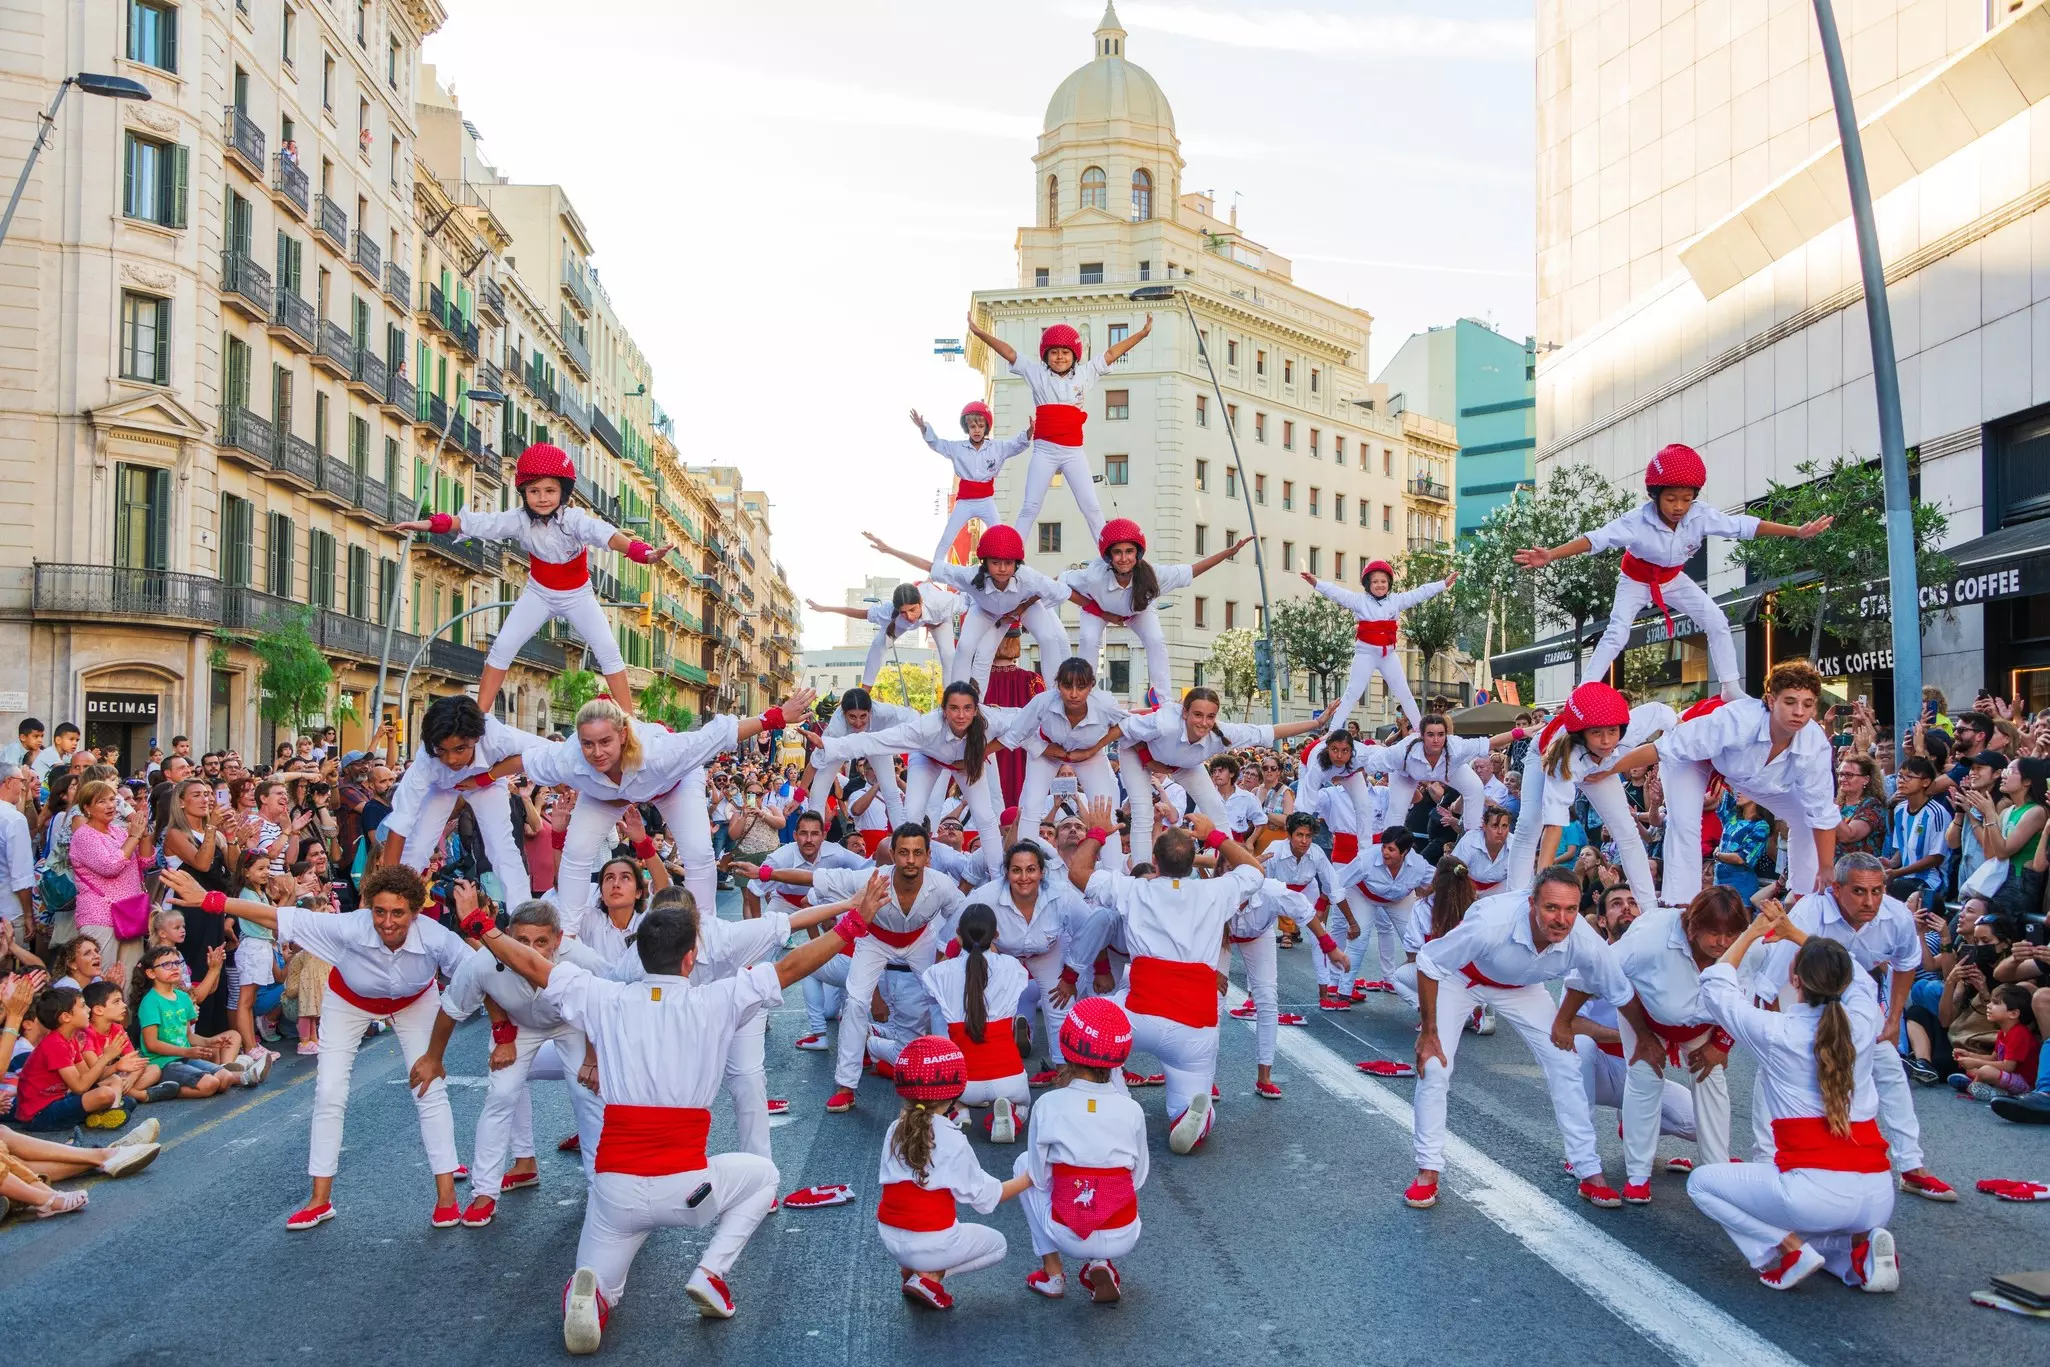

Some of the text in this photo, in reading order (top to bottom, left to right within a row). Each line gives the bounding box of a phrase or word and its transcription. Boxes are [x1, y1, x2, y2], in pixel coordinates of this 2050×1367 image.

[1860, 569, 2020, 618] STACKS COFFEE
[1845, 649, 1895, 674] COFFEE
[88, 700, 156, 714] DECIMAS
[1085, 1025, 1099, 1039] DE
[898, 1057, 910, 1065] DE
